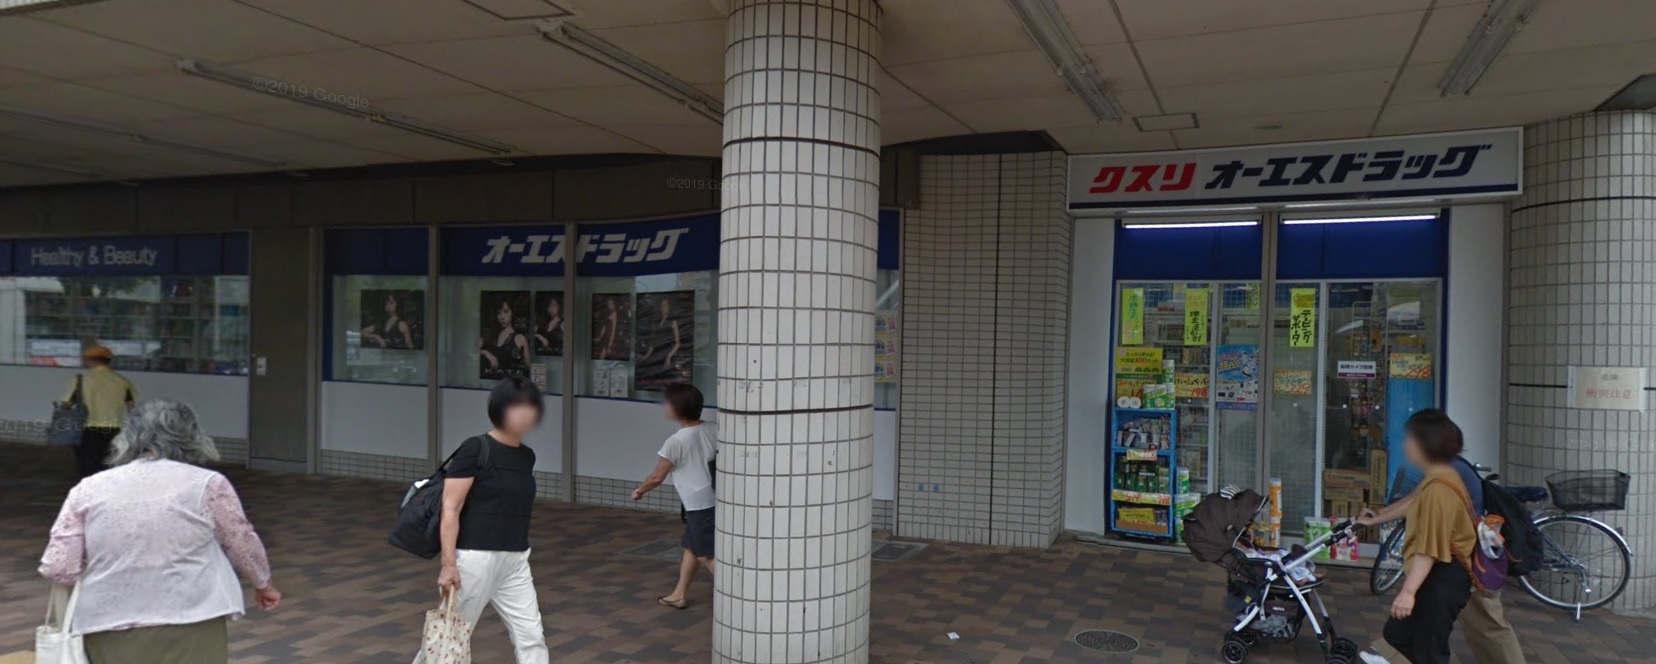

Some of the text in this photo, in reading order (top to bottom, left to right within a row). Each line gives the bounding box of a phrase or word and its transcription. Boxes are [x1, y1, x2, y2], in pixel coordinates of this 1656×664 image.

[1089, 143, 1492, 194] クスリ オーエスドラッグ
[30, 245, 158, 269] Healthy & Beauty
[480, 227, 689, 265] オーエスドラッグ
